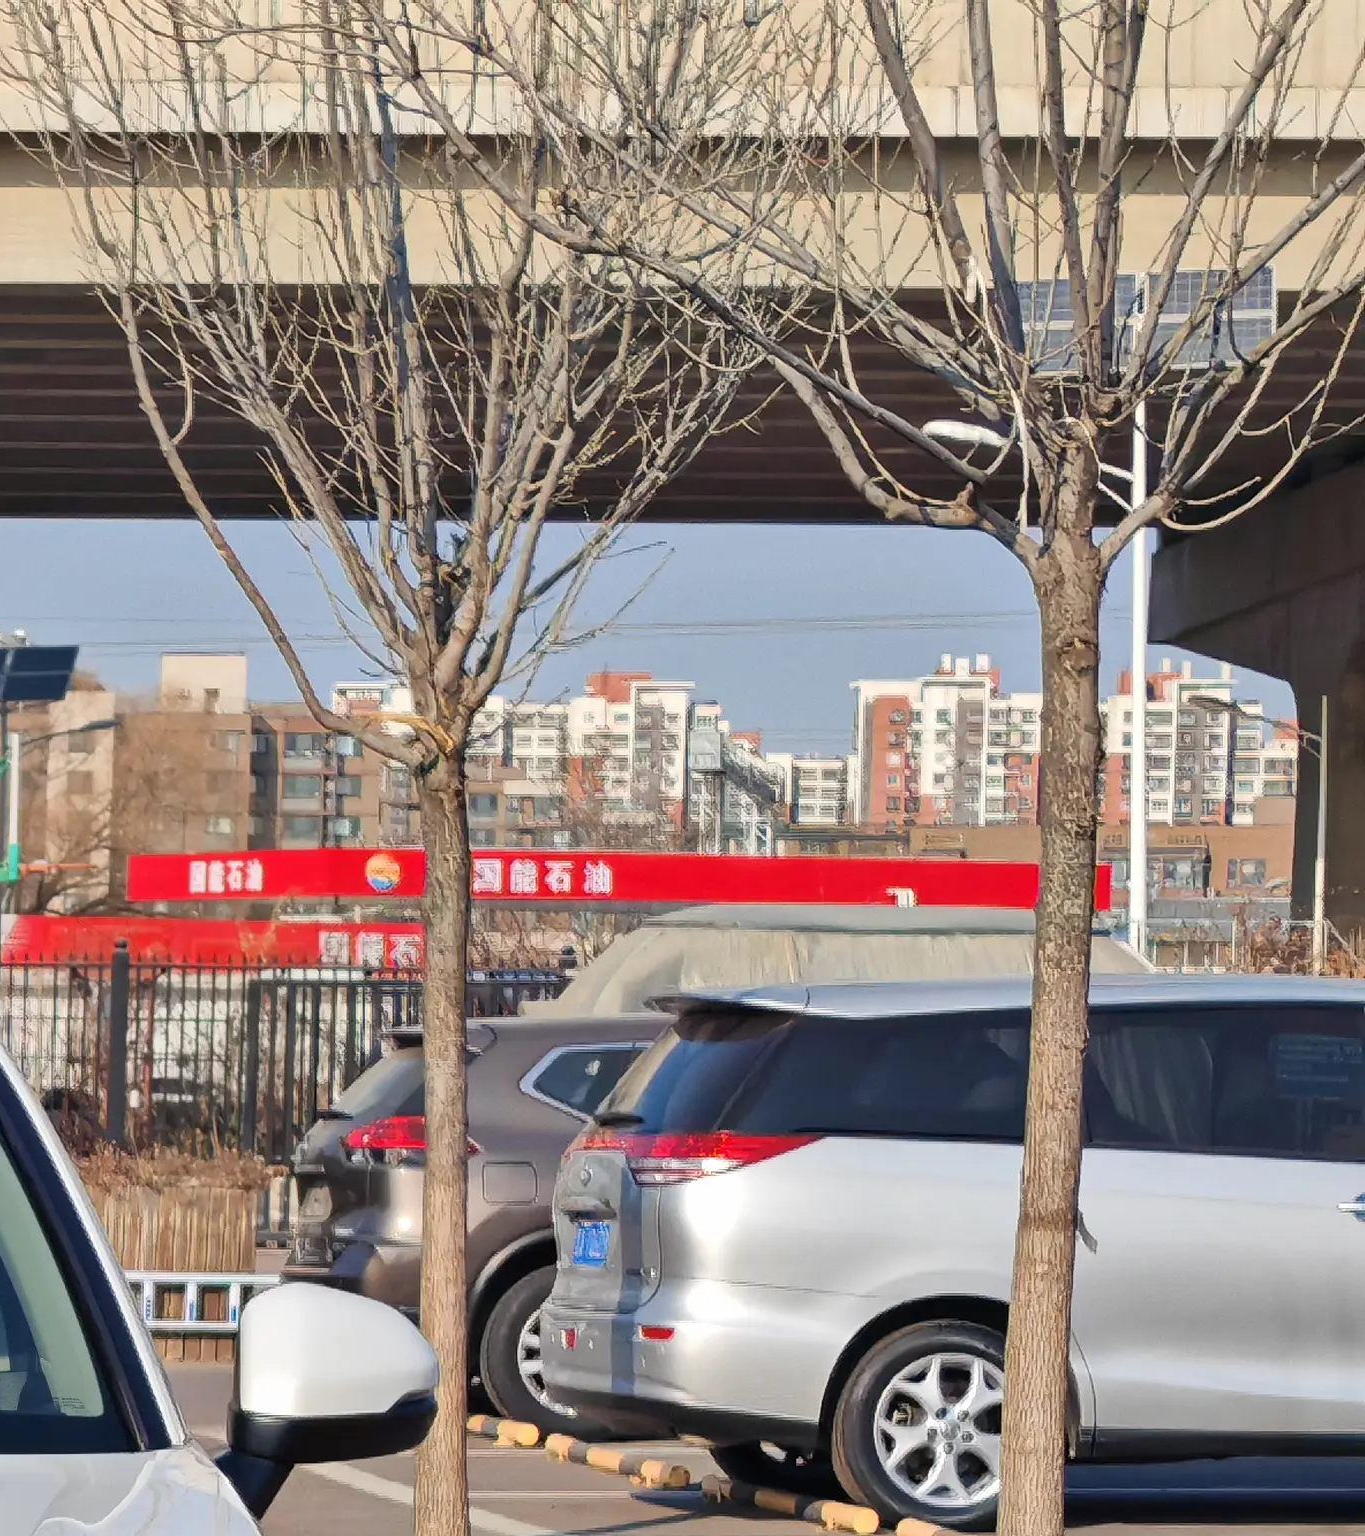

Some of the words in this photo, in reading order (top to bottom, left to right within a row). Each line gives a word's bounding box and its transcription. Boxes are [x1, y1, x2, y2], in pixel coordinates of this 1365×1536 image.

[472, 859, 613, 894] 国能石油
[319, 932, 426, 968] 国能石
